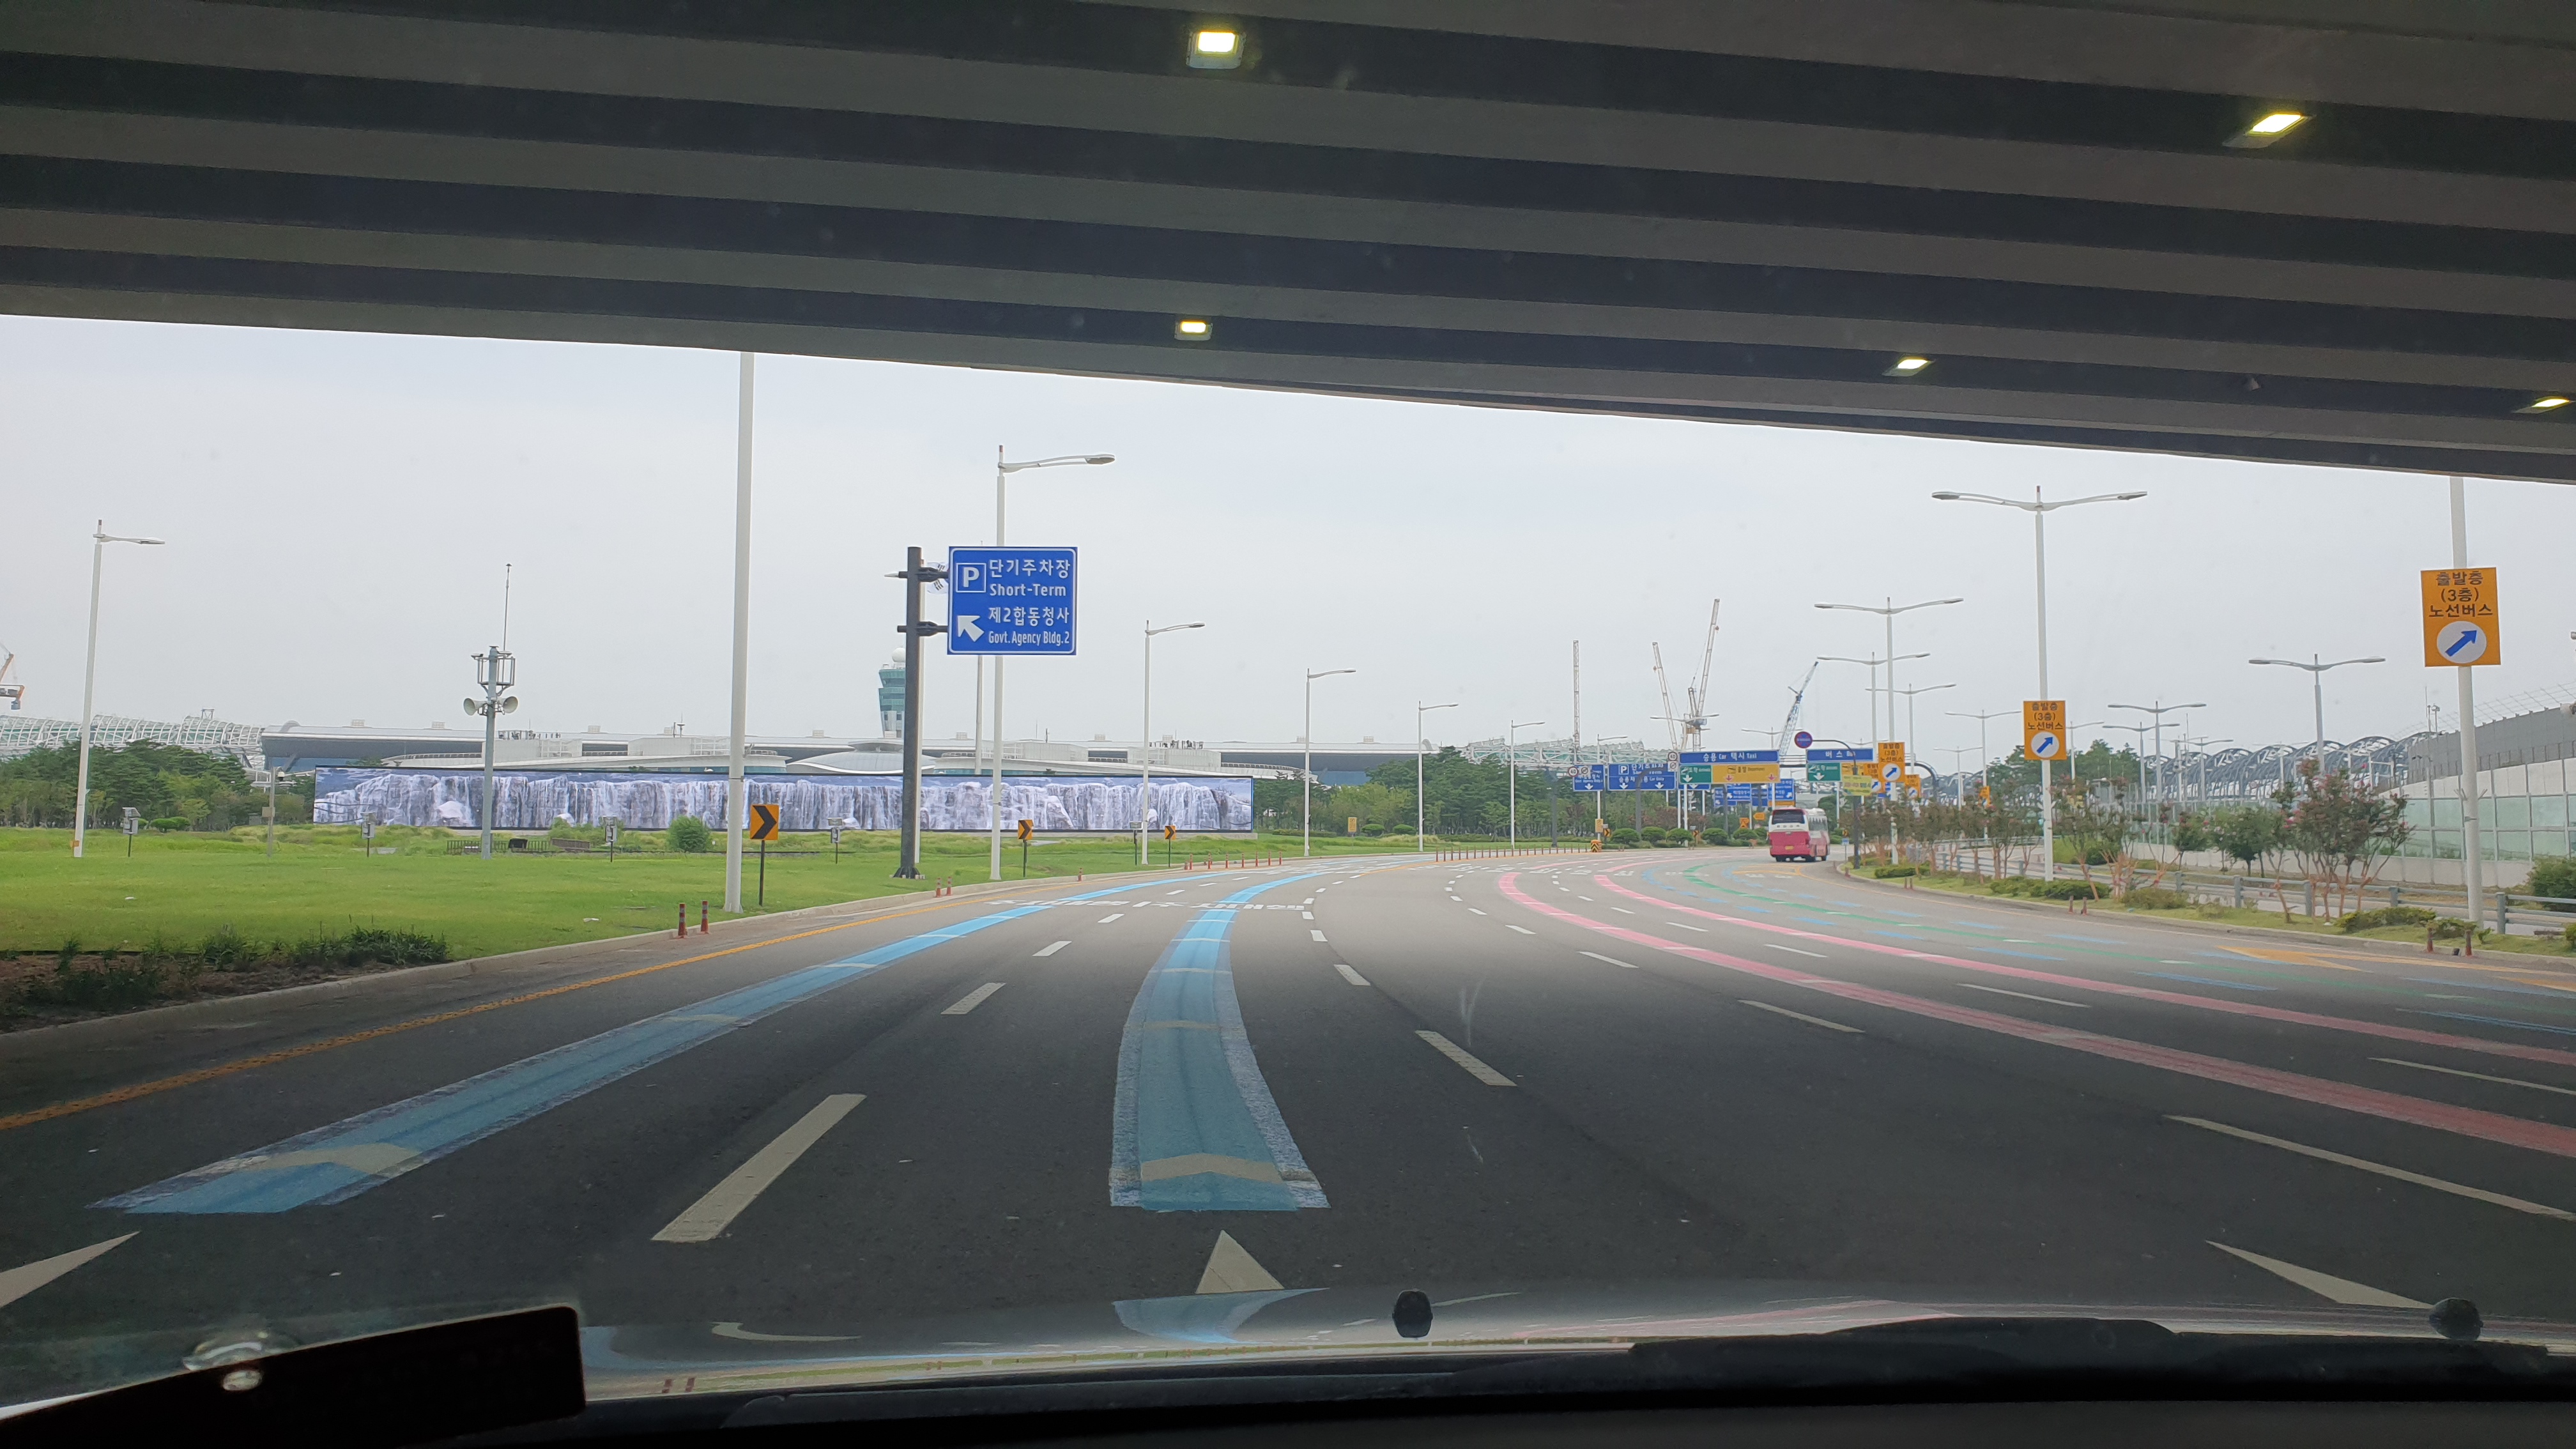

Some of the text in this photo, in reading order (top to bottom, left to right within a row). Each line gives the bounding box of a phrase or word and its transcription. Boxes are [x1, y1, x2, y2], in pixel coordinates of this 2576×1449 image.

[989, 559, 1071, 579] 단기주차장
[963, 567, 979, 588] P
[2435, 570, 2483, 586] 출발층
[990, 583, 1066, 596] Short-Term
[2441, 587, 2480, 602] (3층)
[988, 606, 1070, 627] 제2합동청사
[2428, 604, 2493, 618] 노선버스
[1011, 631, 1041, 647] Agency
[2028, 722, 2063, 731] 노선버스
